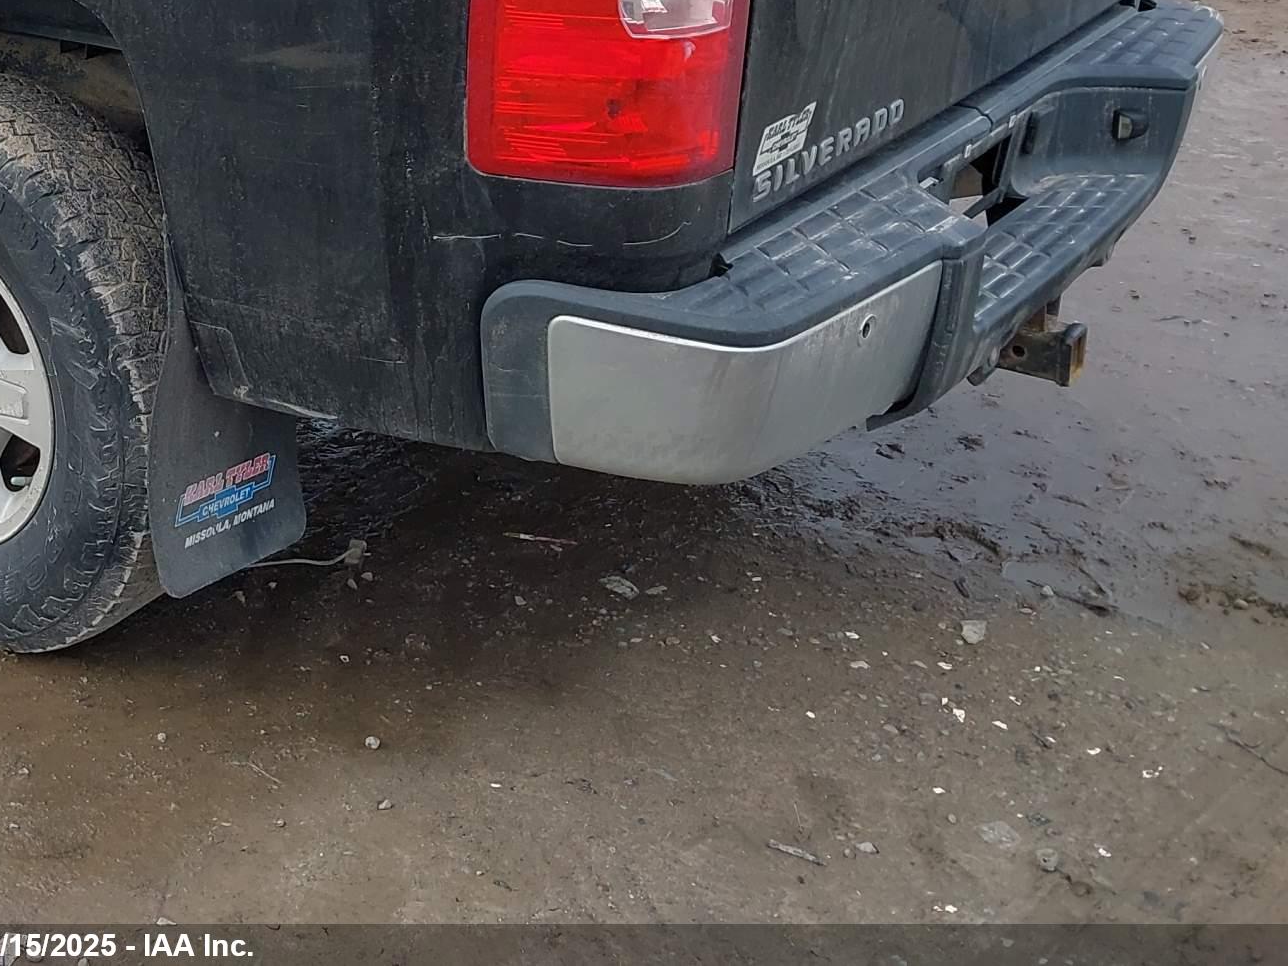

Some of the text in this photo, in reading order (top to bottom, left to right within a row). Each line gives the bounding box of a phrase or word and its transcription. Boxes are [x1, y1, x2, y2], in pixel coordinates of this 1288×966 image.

[752, 97, 906, 204] SILVERADO
[182, 452, 271, 507] KARL TYLER
[202, 487, 252, 517] CHEVROLET
[232, 498, 275, 526] MONTANA
